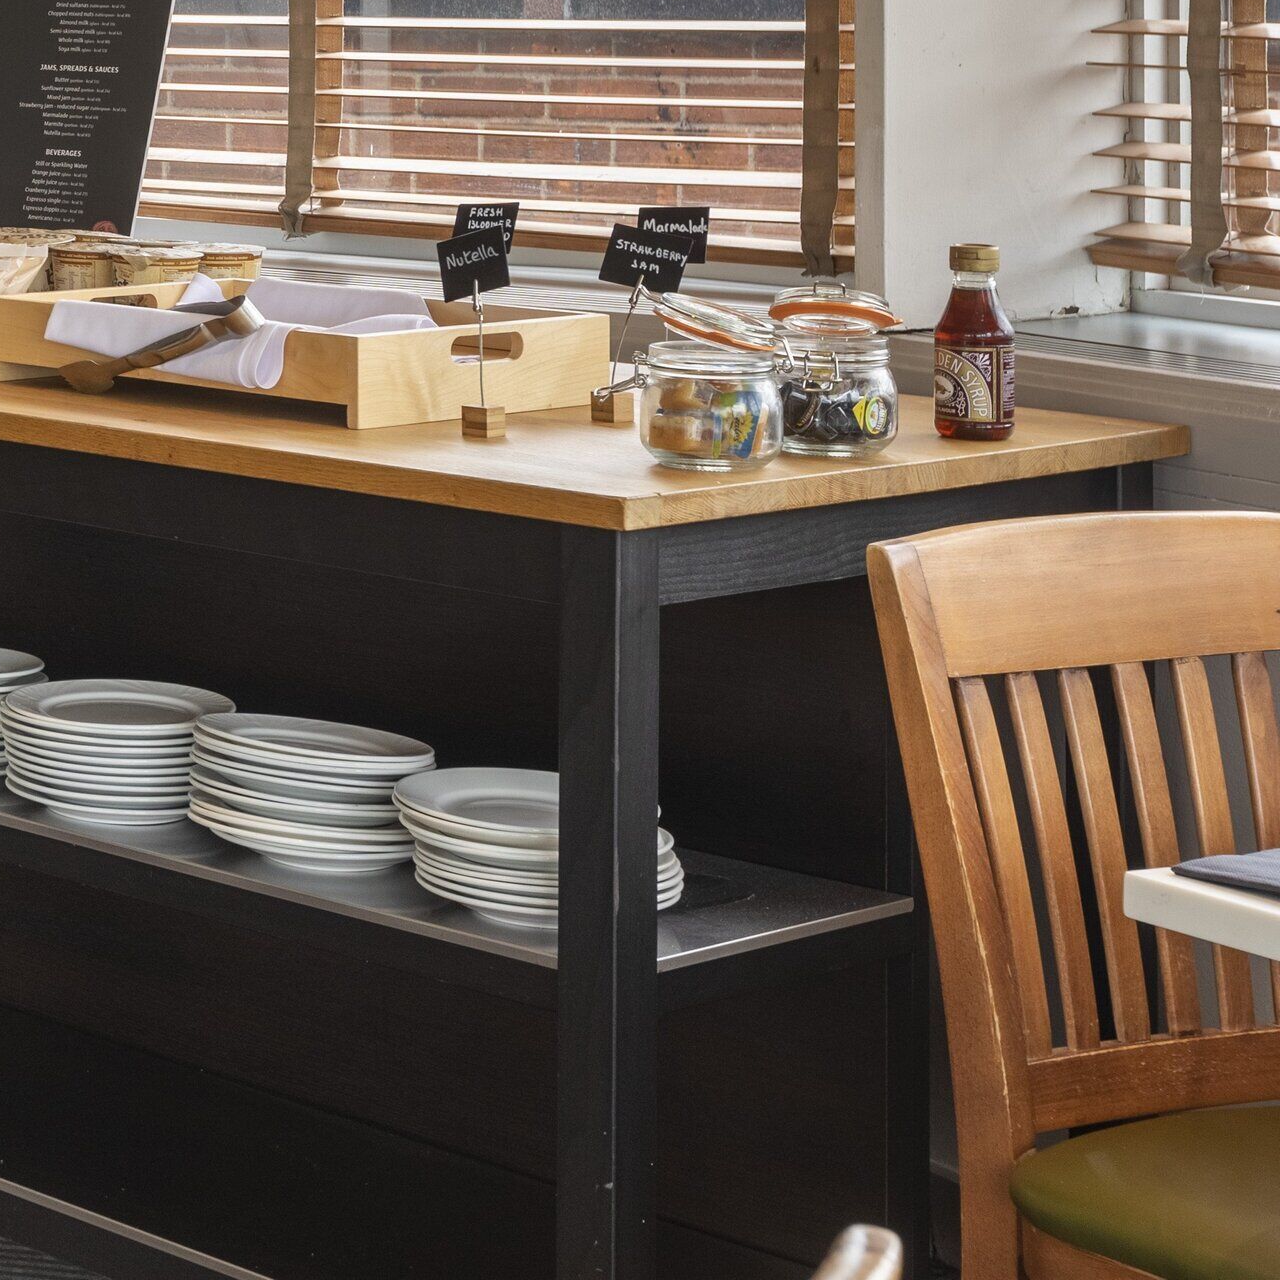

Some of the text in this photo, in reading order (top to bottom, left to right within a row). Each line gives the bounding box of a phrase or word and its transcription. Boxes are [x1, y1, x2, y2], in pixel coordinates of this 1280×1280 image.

[46, 149, 82, 157] BEVERAGES
[469, 208, 503, 217] FRESH
[643, 217, 708, 234] Marmalade
[446, 244, 499, 270] Nutella
[616, 239, 688, 267] STRAWBERRY
[961, 370, 988, 417] SYRUP
